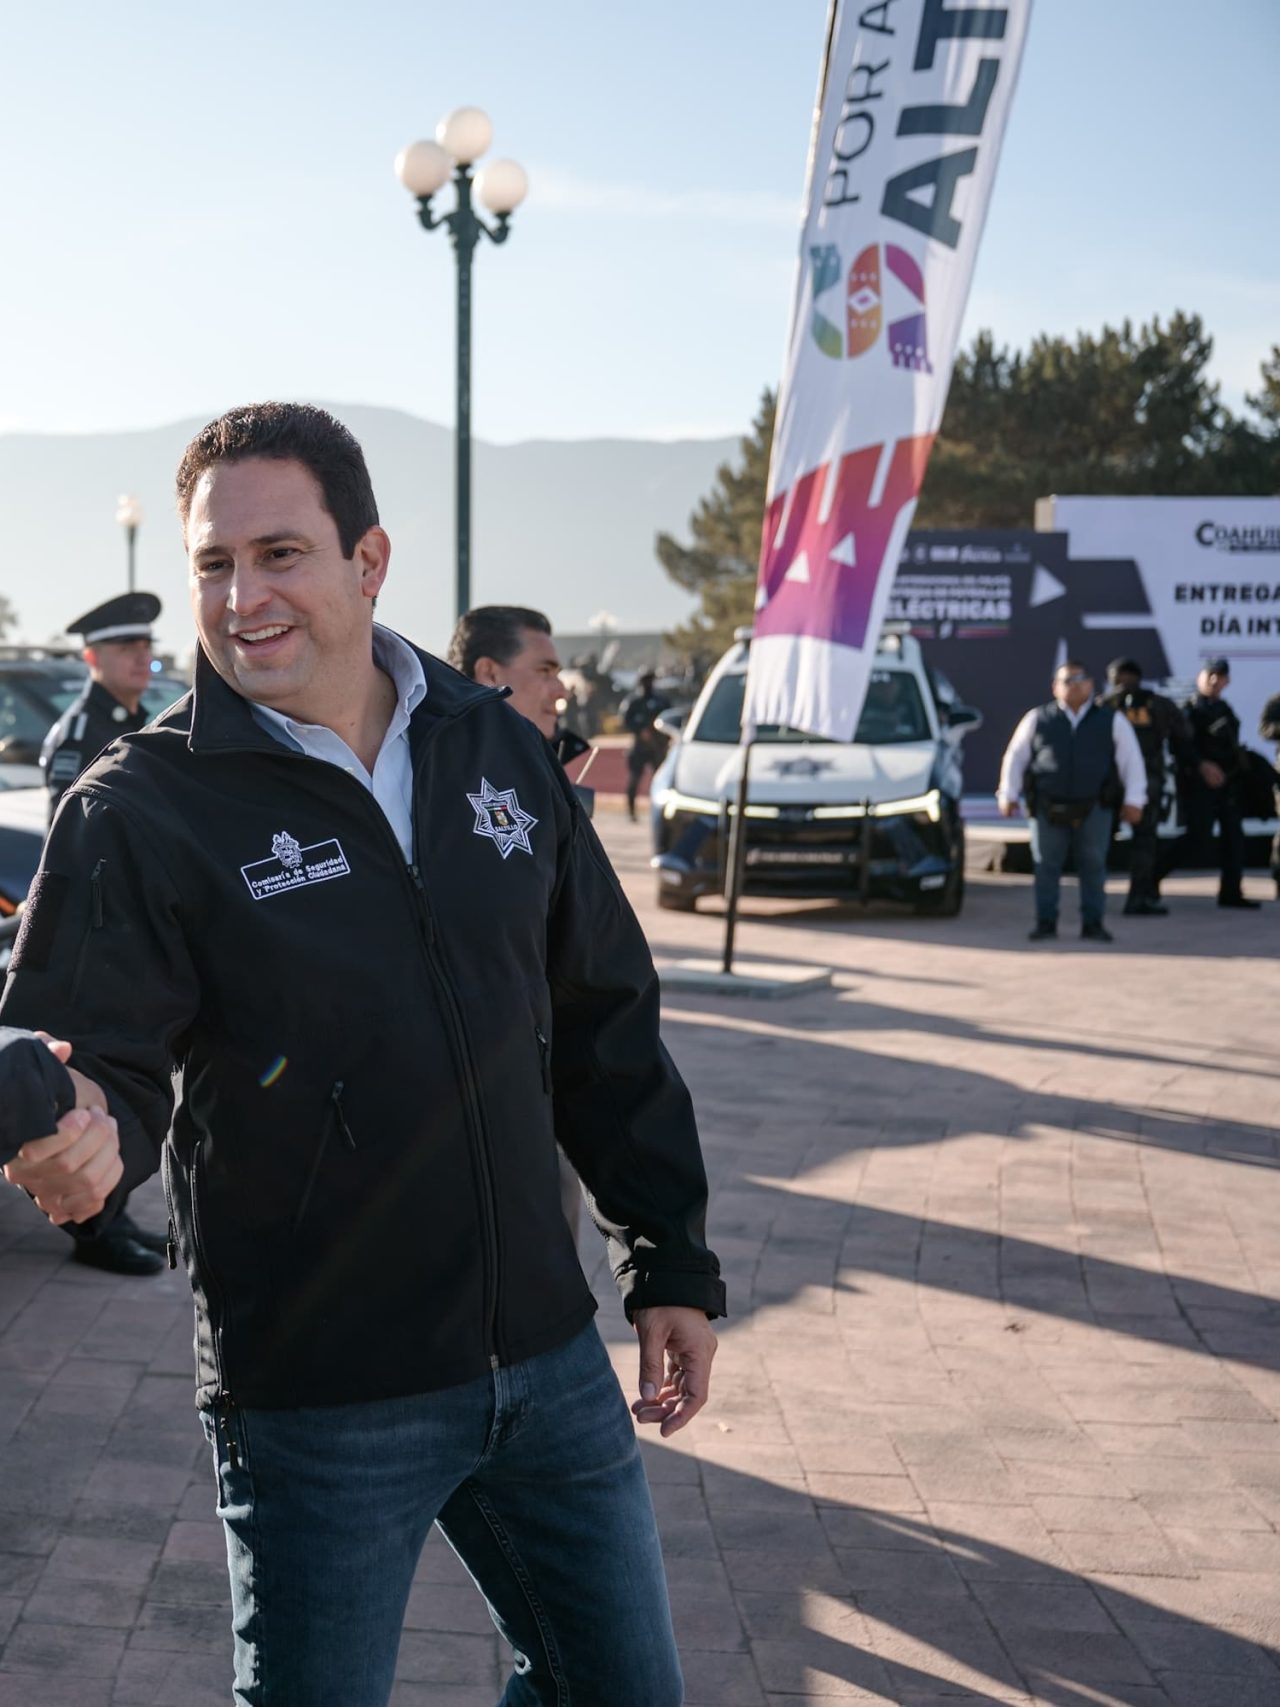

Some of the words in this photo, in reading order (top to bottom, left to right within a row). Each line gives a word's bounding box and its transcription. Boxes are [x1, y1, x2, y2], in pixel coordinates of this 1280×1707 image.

[822, 58, 892, 210] POR
[1200, 609, 1242, 635] DÍA
[305, 855, 344, 873] Seguridad
[307, 863, 347, 880] Ciudadana
